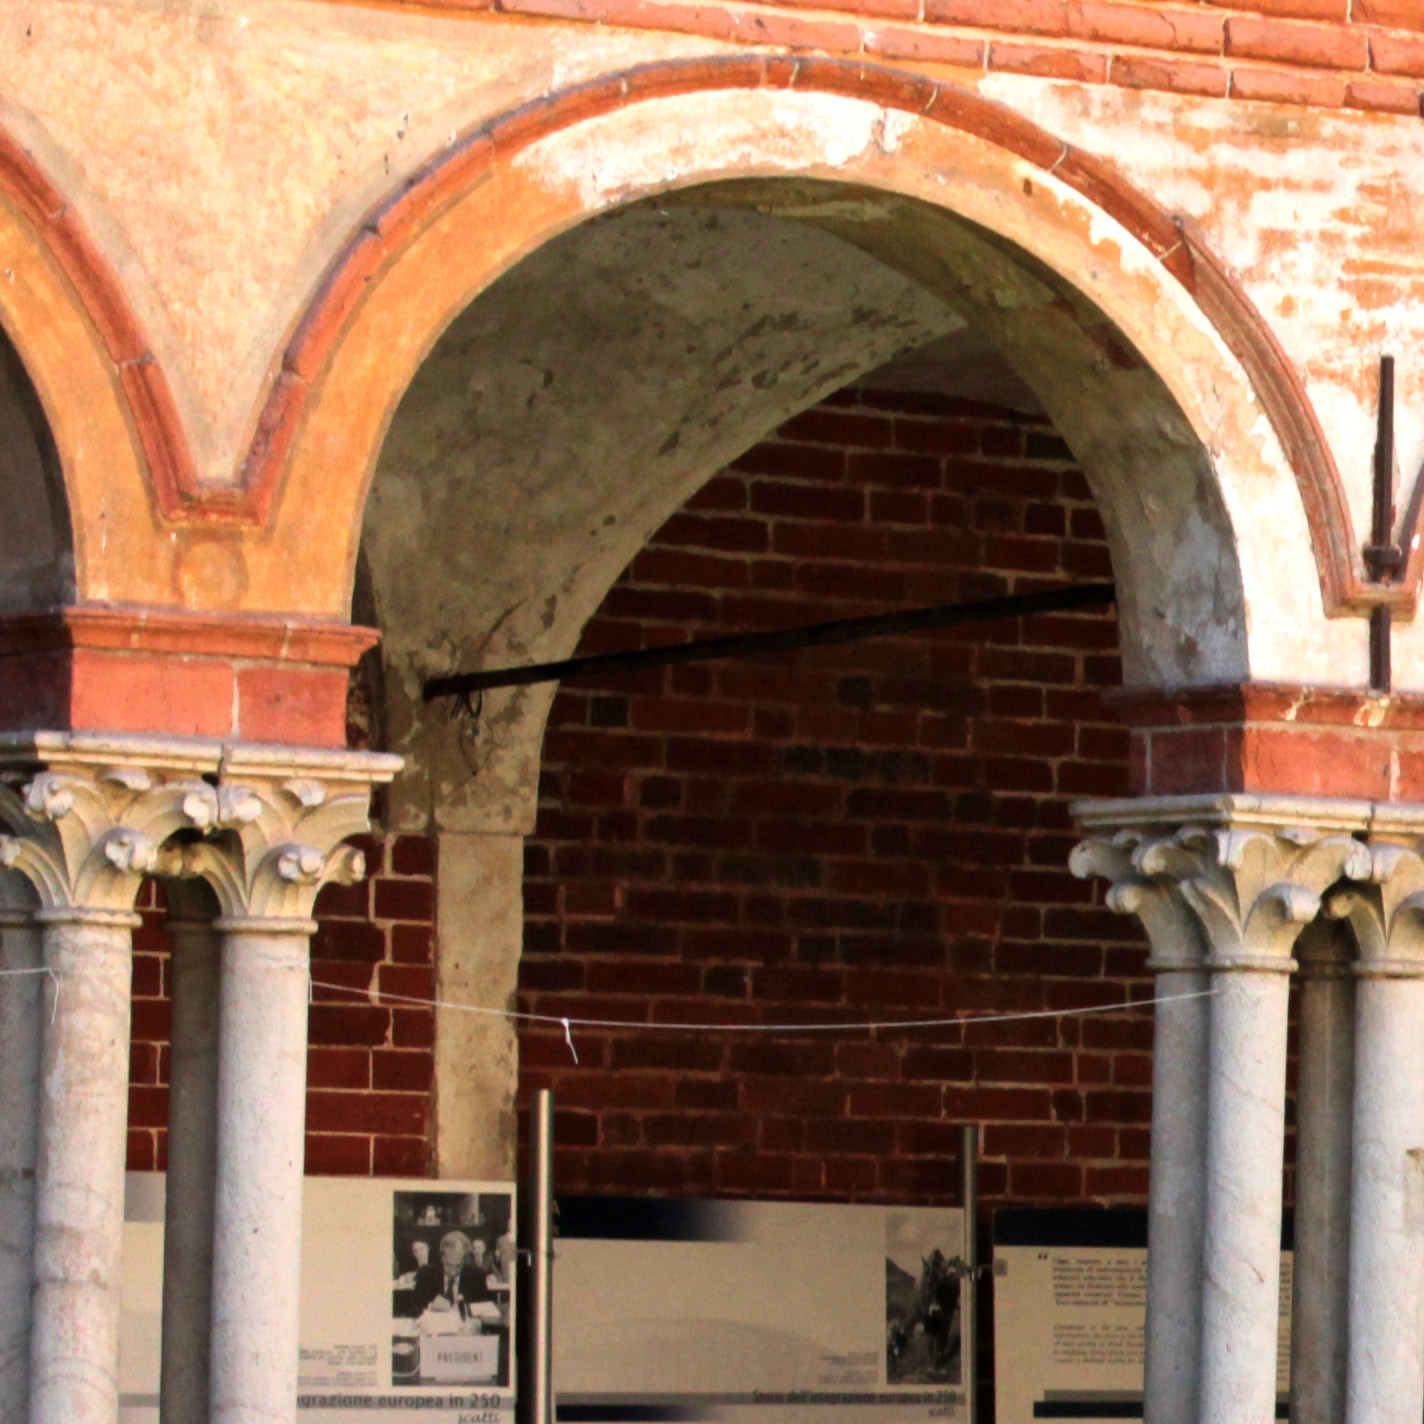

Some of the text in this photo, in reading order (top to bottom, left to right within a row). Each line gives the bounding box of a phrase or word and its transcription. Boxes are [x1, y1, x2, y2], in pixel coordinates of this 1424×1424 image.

[378, 1395, 444, 1410] europea
[448, 1392, 465, 1409] in
[469, 1392, 502, 1409] 250
[753, 1389, 784, 1404] Storia
[879, 1392, 921, 1406] europea
[924, 1390, 935, 1404] in
[937, 1389, 957, 1404] 250
